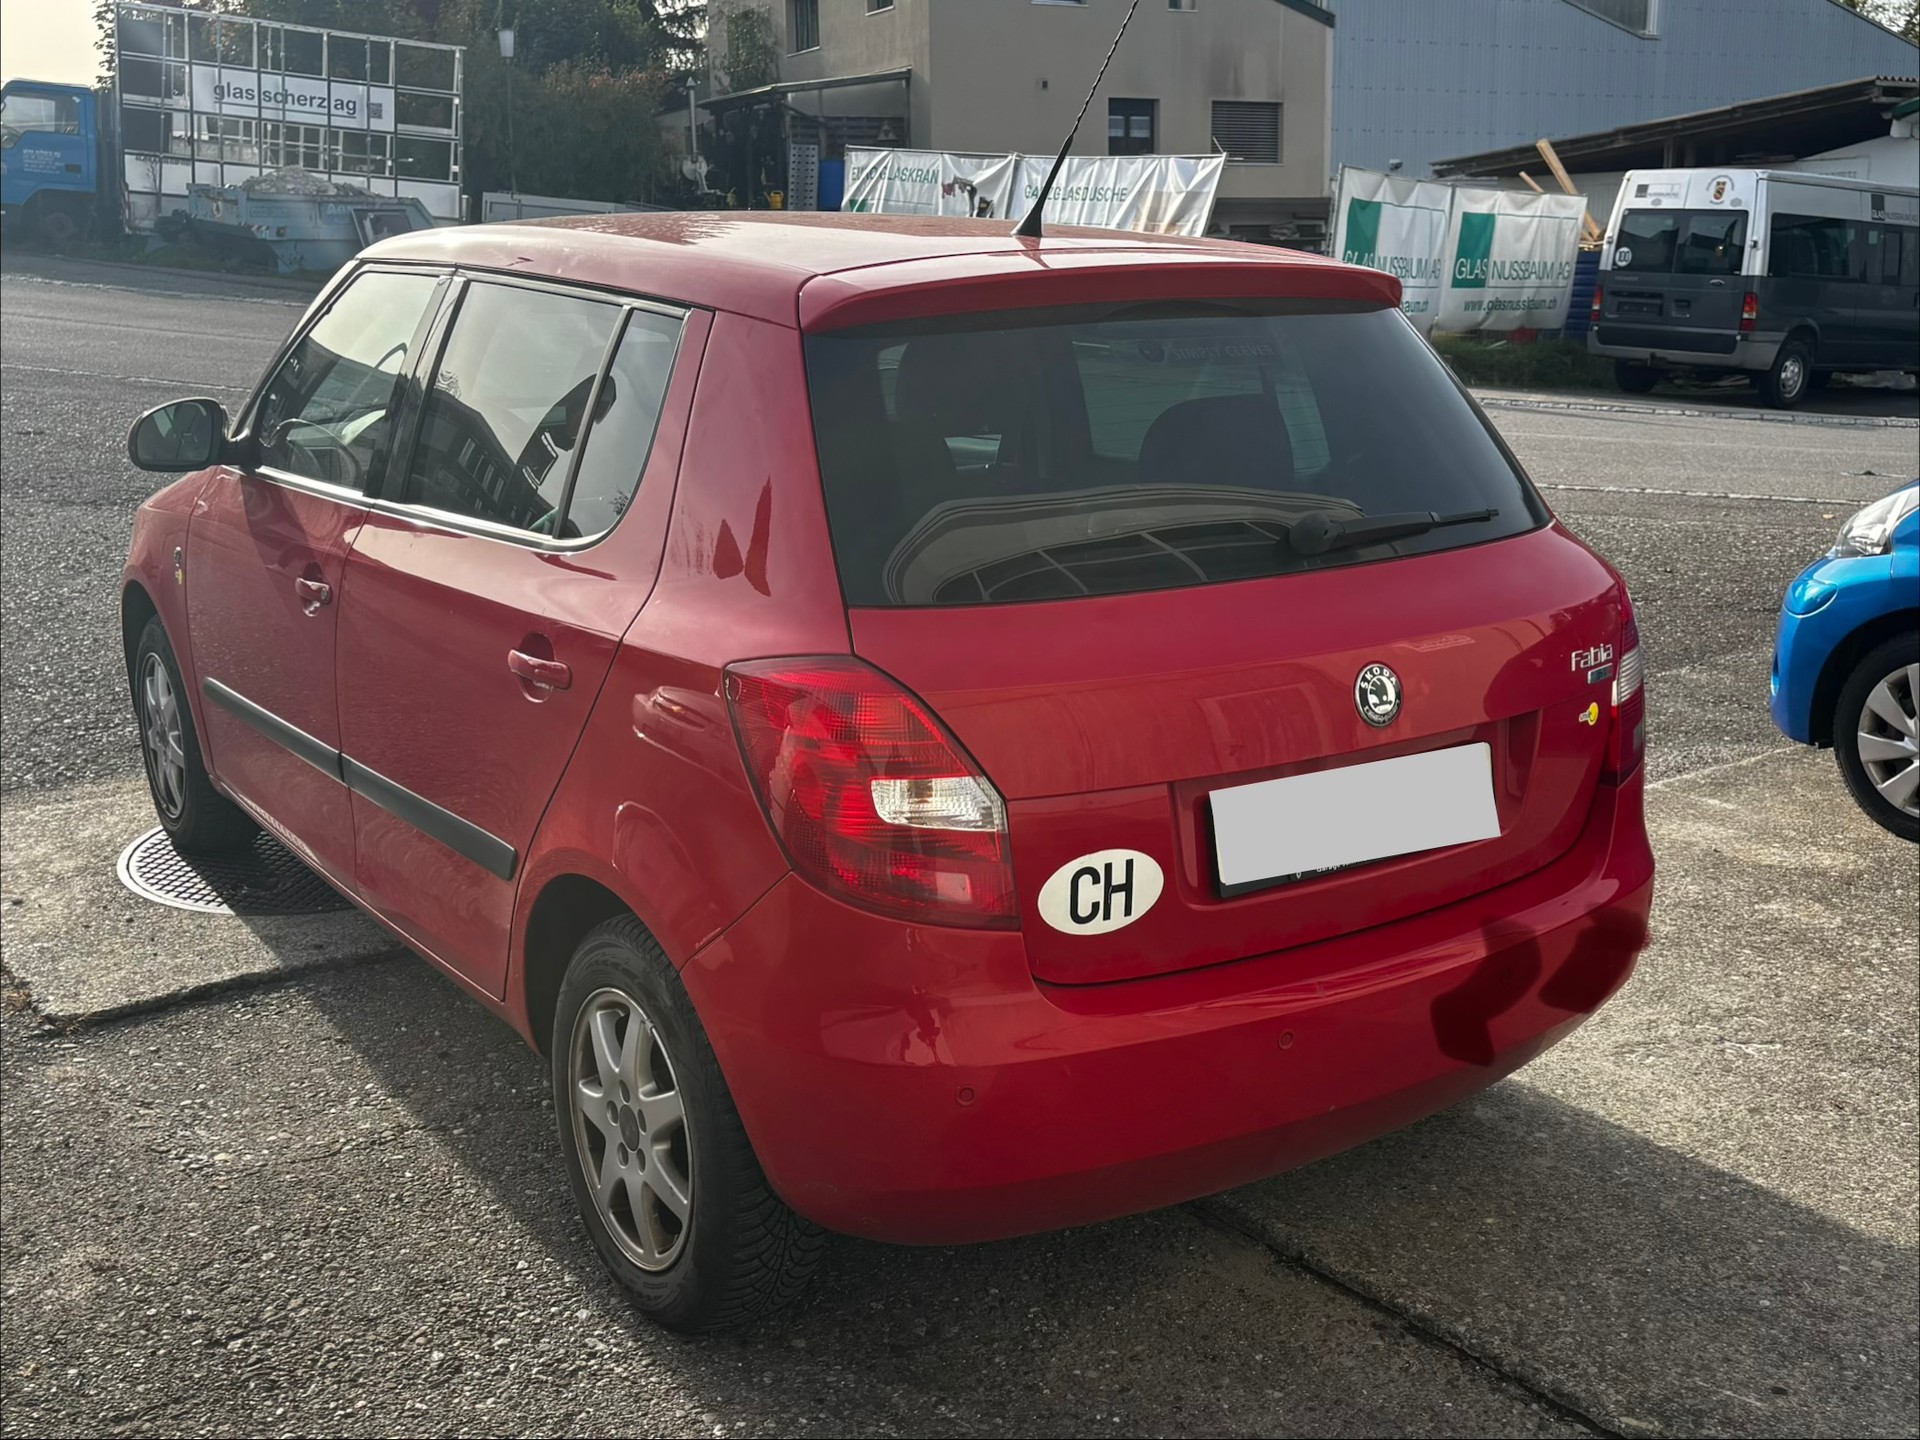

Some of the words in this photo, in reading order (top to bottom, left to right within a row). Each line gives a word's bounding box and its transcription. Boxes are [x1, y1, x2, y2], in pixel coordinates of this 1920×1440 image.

[213, 81, 256, 101] glas
[262, 88, 328, 109] scherz
[333, 97, 358, 116] ag
[1024, 184, 1128, 202] GAZGLASDUSCHE
[1344, 250, 1375, 269] GLAS
[1455, 257, 1488, 279] GLAS
[1491, 260, 1555, 281] NUSSBAUM
[1556, 260, 1572, 281] AG
[1571, 643, 1613, 672] Fabia
[1069, 858, 1134, 925] CH
